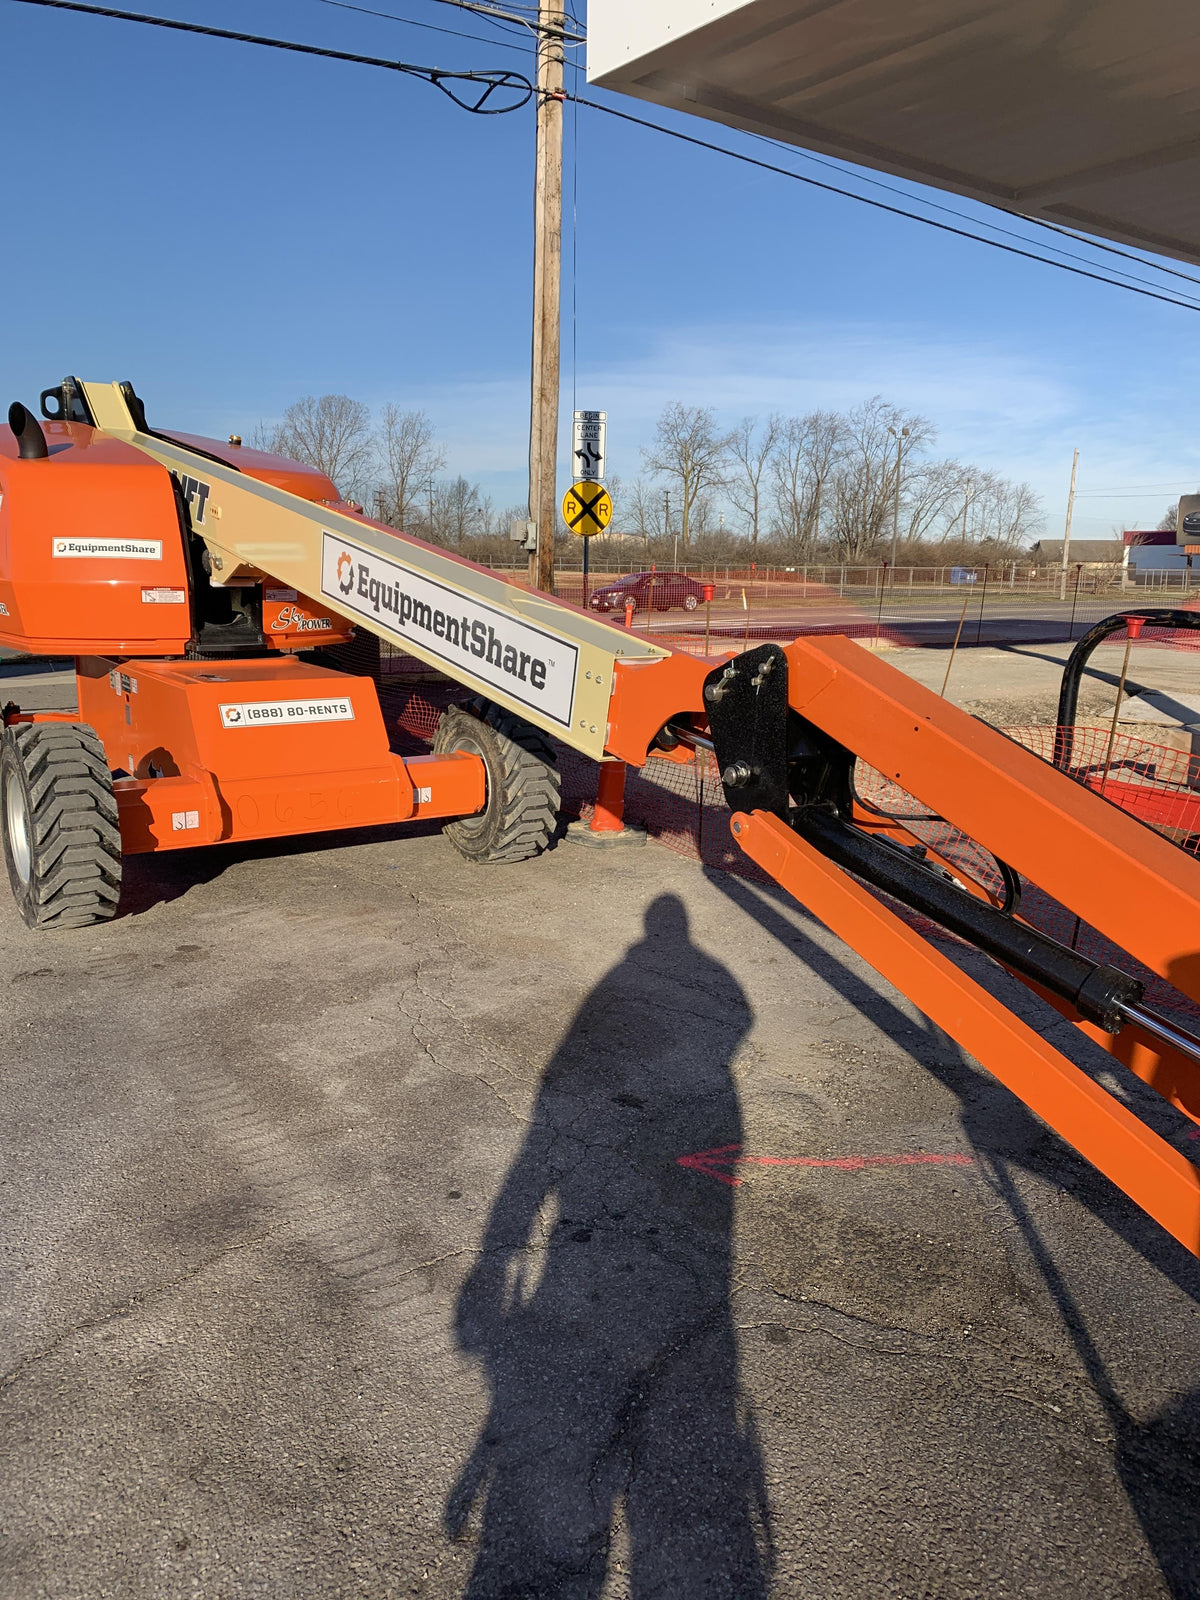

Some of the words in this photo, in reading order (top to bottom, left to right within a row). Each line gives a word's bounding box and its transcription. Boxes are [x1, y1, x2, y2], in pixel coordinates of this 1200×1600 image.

[567, 501, 577, 515] R
[599, 503, 609, 517] R
[68, 543, 156, 554] EquipmentShare
[357, 563, 547, 691] EquipmentShare
[247, 707, 284, 719] (888)
[287, 704, 348, 716] 80-RENTS
